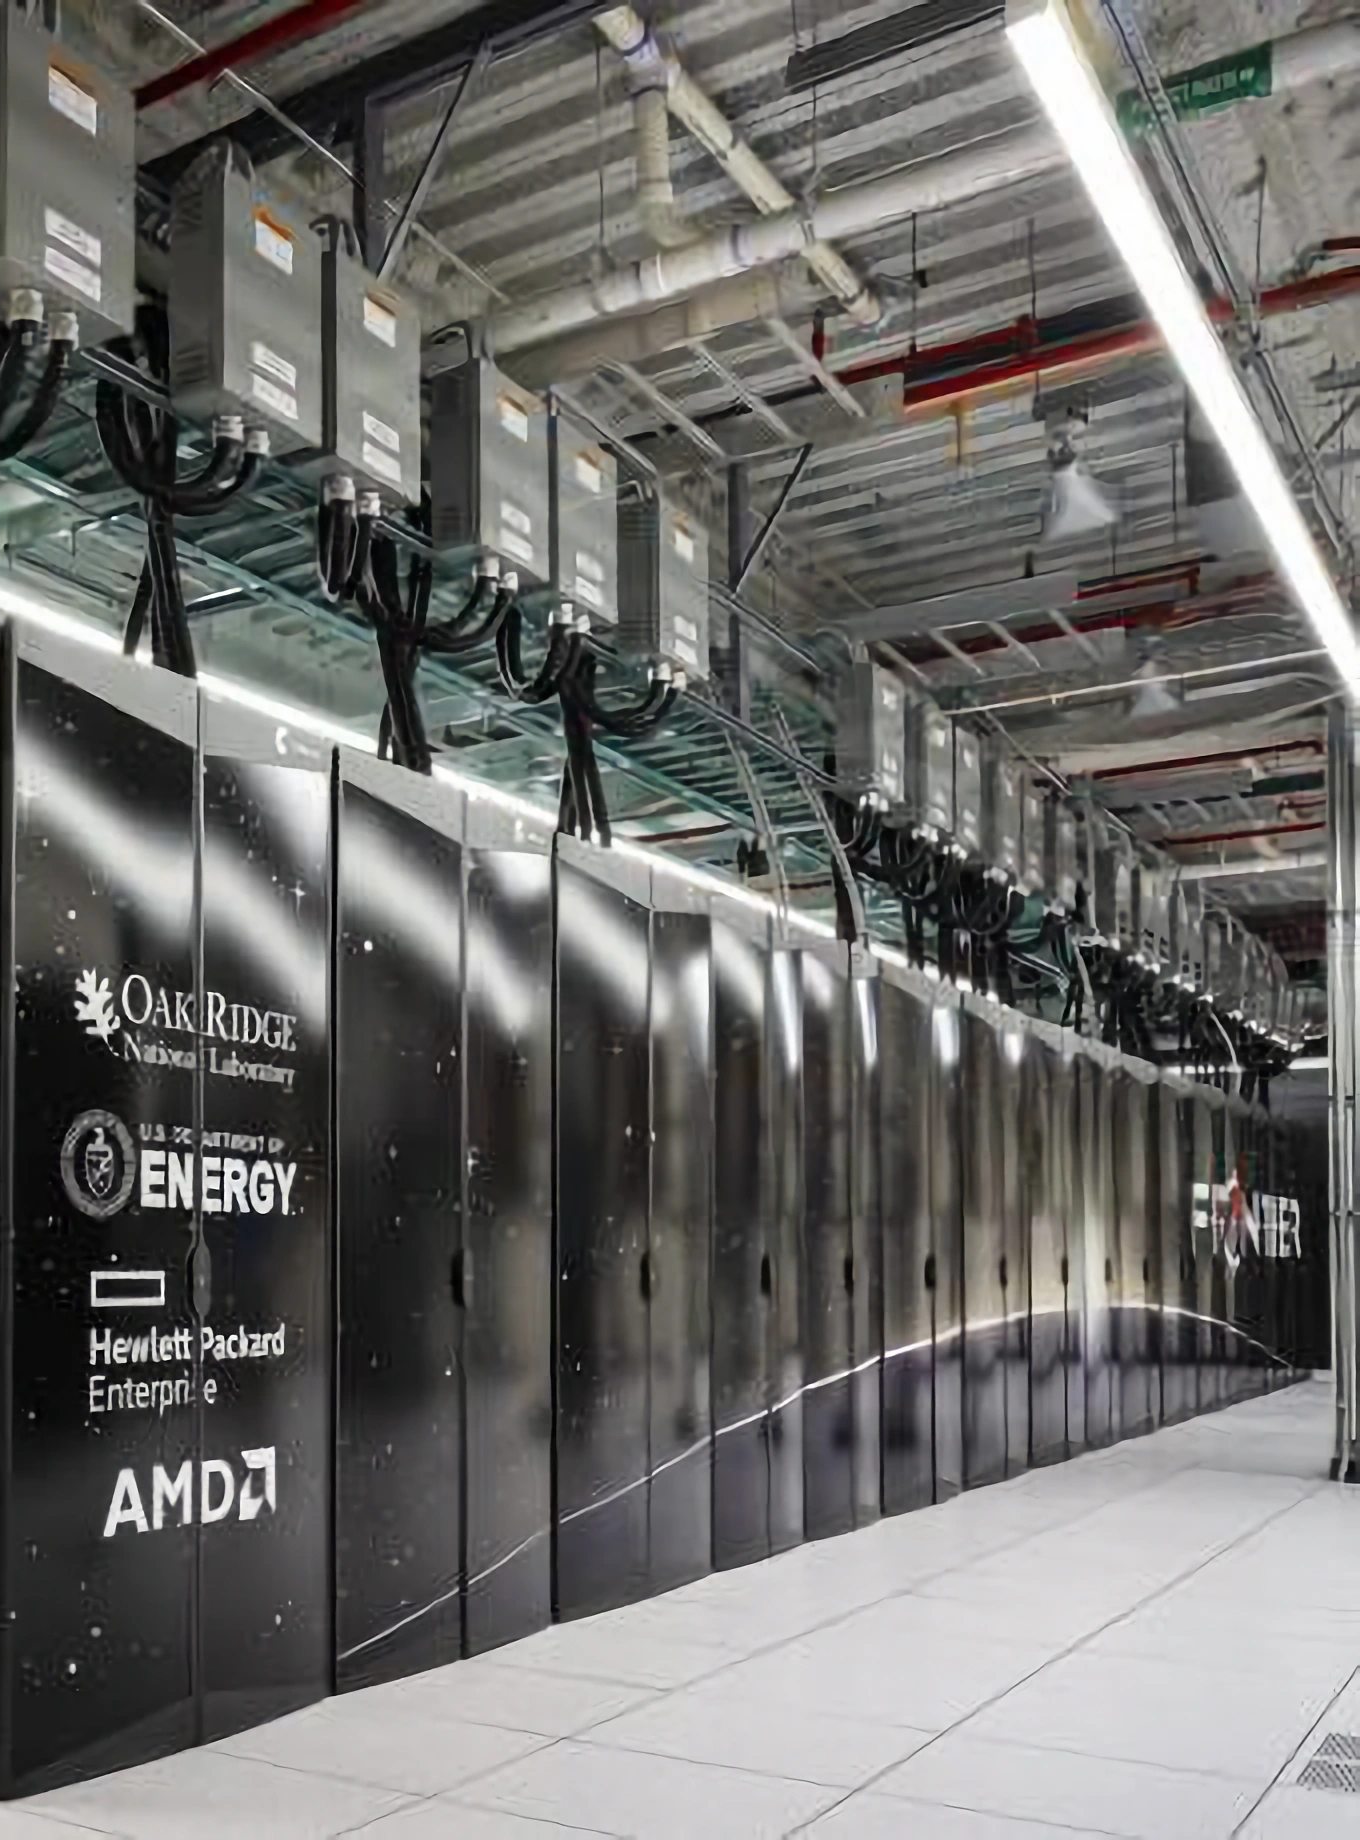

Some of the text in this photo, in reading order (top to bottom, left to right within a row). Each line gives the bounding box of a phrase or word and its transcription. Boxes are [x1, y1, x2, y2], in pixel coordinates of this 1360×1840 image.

[140, 1149, 297, 1216] ENERGY
[89, 1322, 286, 1365] Hewlett Packard
[89, 1370, 218, 1418] Enterprie
[103, 1459, 235, 1538] AMD
